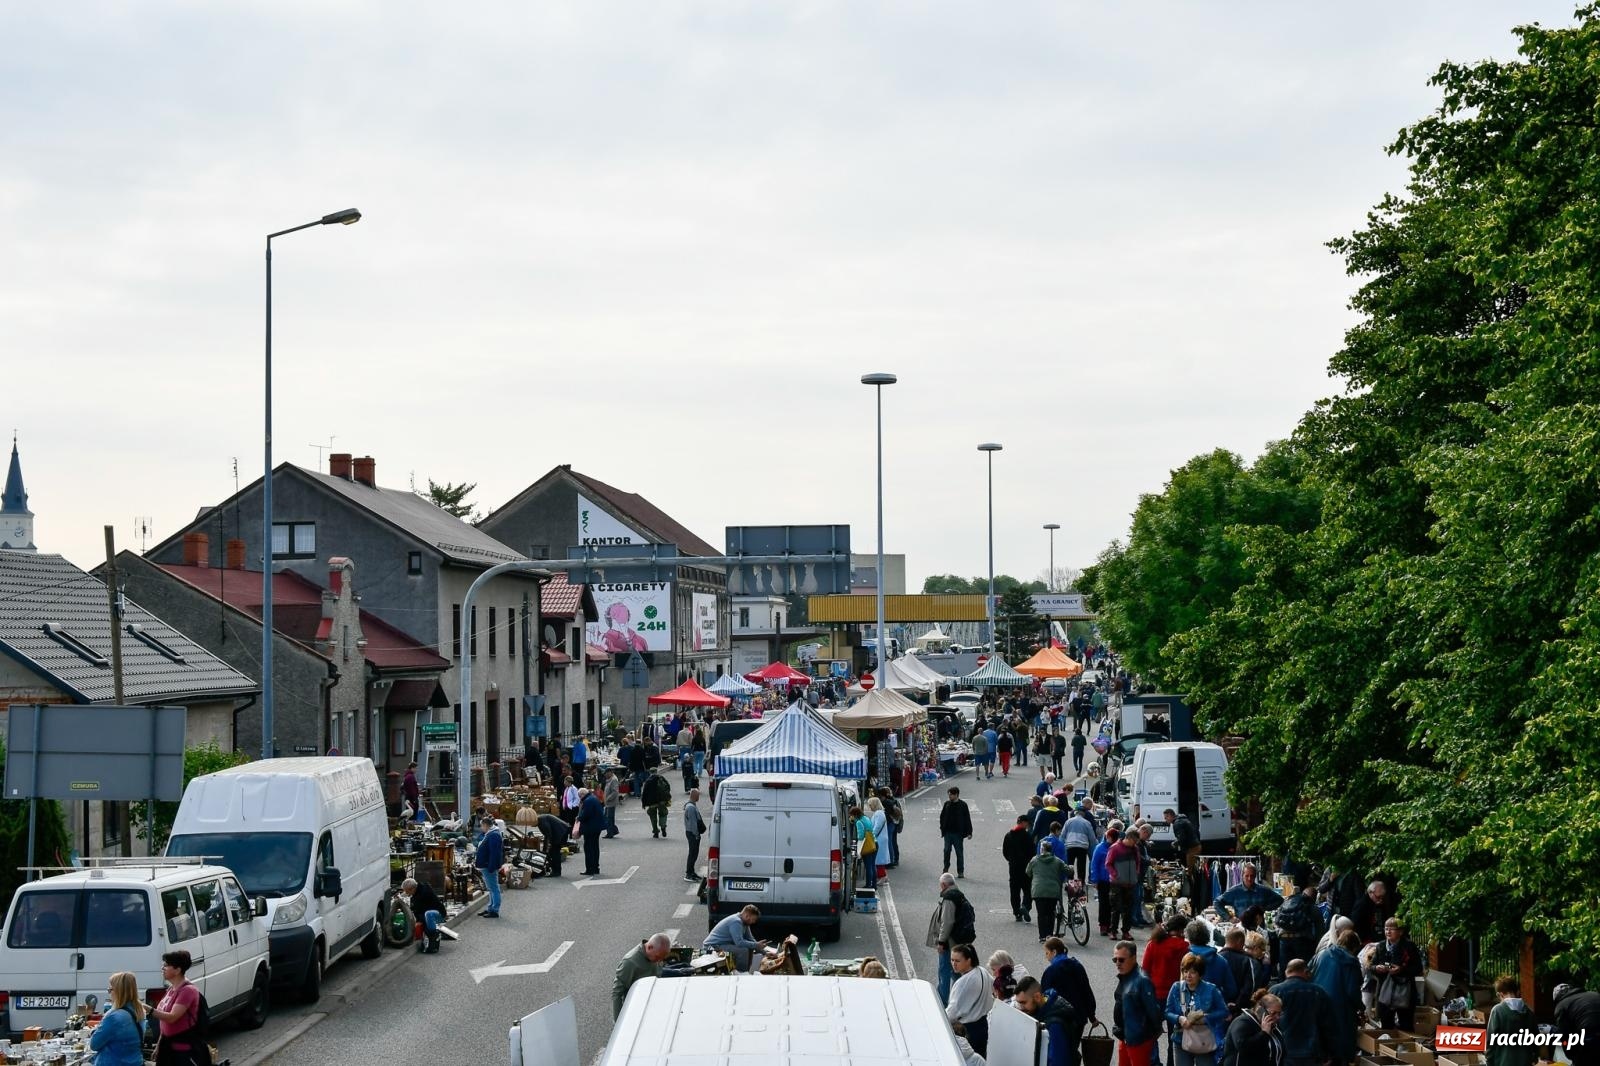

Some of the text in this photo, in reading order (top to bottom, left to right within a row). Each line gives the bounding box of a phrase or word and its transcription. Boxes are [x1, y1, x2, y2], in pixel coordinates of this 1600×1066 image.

[583, 537, 631, 545] KANTOR
[598, 583, 666, 592] CIGARETY
[637, 621, 667, 631] 24H
[23, 997, 67, 1007] SH 2304G
